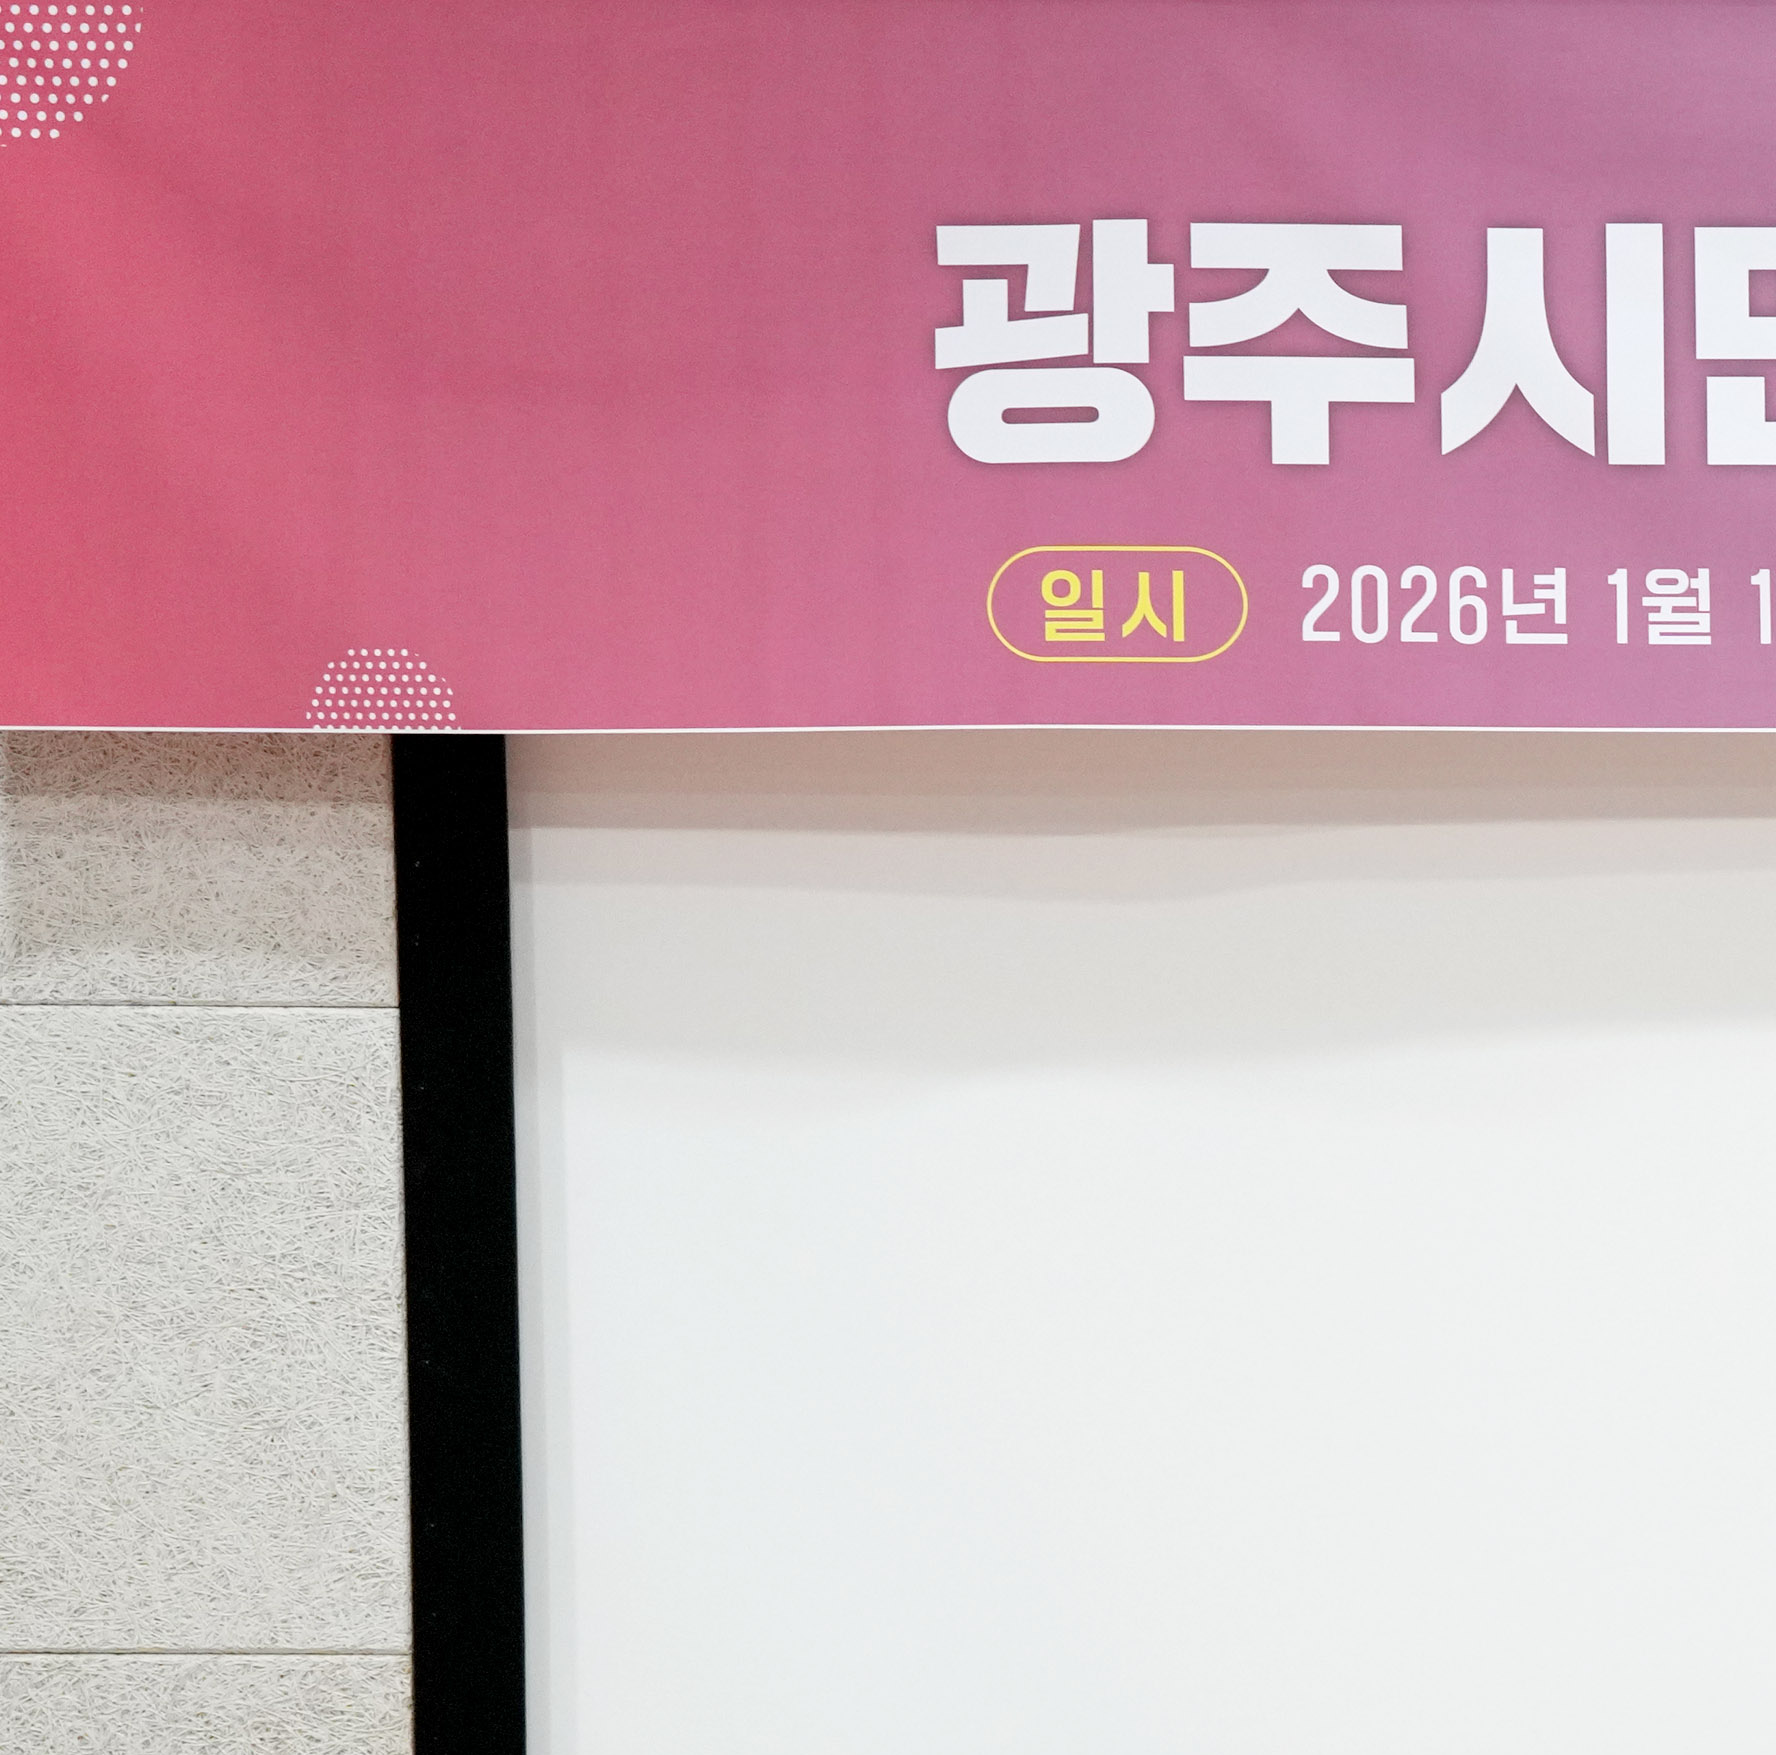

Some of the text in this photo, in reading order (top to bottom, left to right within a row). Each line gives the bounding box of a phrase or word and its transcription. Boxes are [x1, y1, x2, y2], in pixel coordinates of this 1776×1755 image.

[1040, 568, 1186, 643] 일시
[1301, 563, 1569, 646] 2026년
[1606, 566, 1713, 646] 1월
